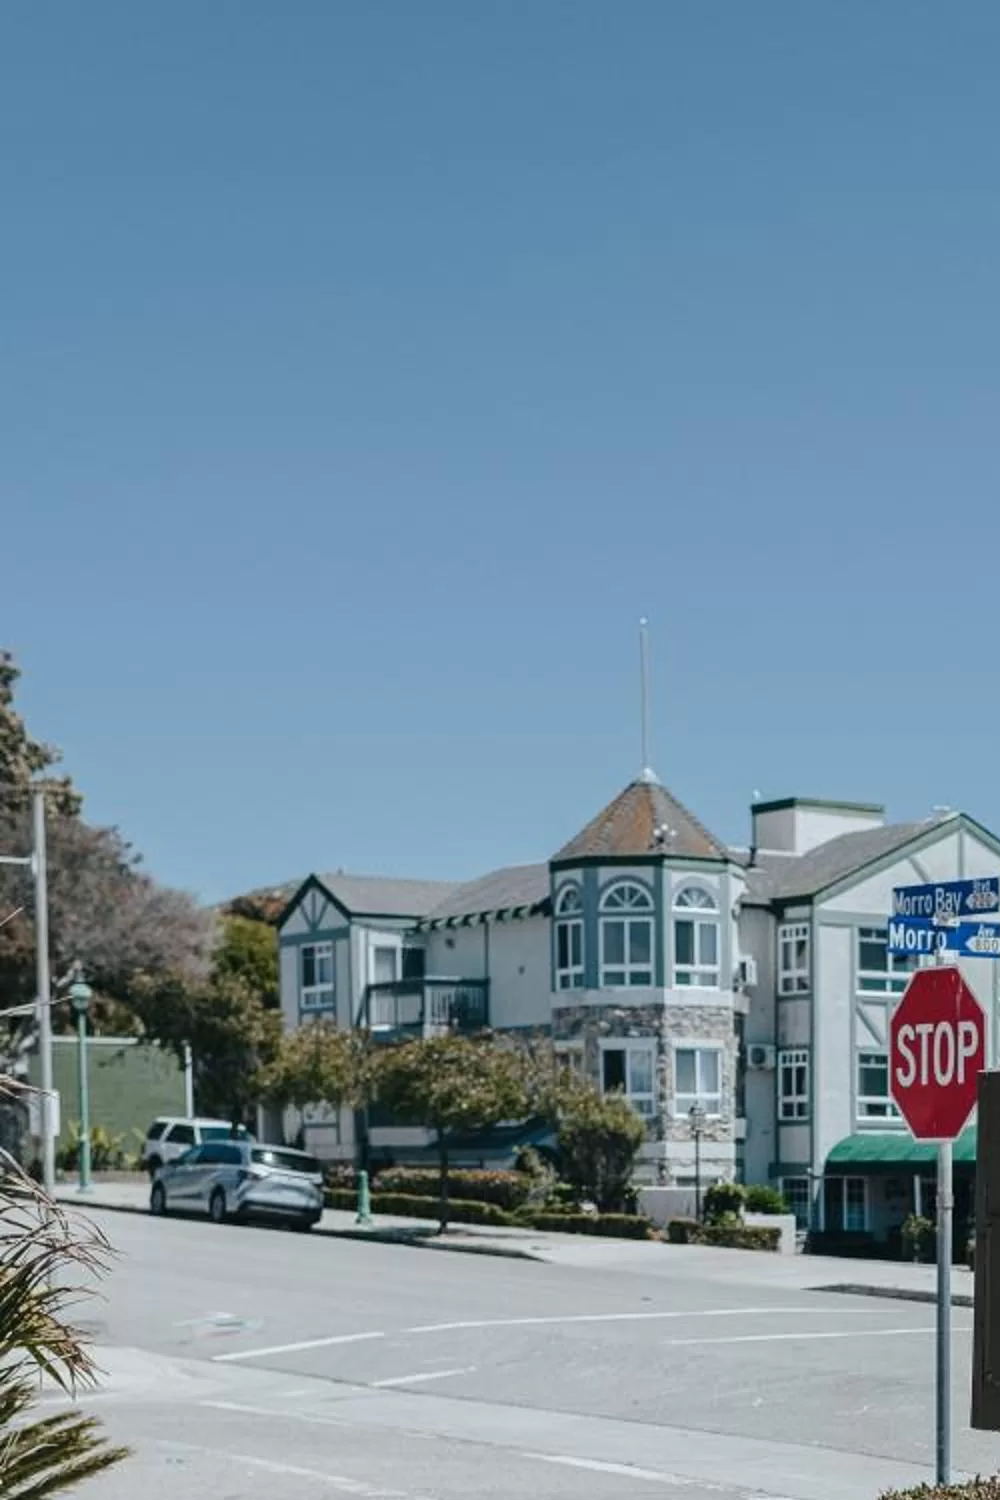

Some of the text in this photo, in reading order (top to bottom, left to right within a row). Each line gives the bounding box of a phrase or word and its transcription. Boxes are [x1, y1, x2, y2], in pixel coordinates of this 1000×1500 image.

[893, 891, 933, 916] Morro
[935, 887, 962, 914] Bay
[889, 923, 947, 951] Morro
[895, 1020, 979, 1087] STOP
